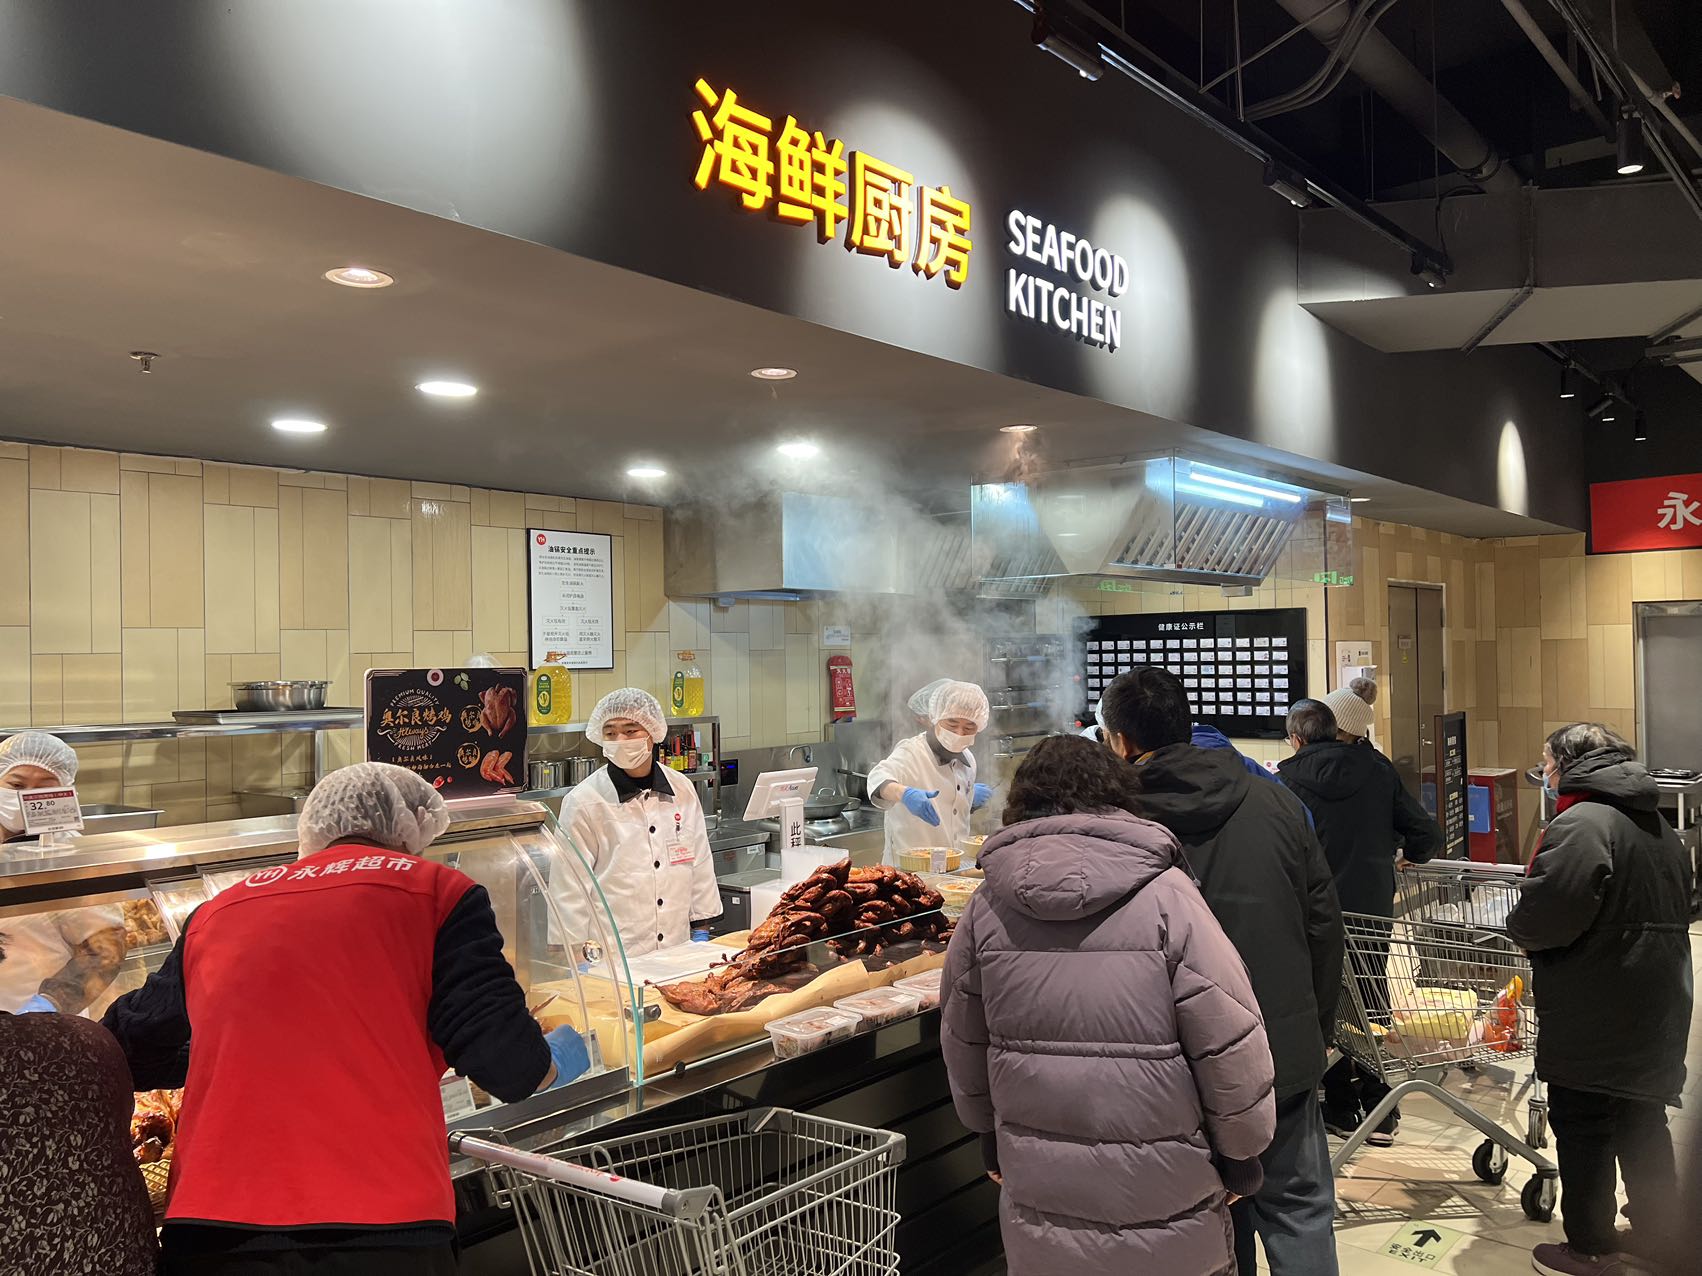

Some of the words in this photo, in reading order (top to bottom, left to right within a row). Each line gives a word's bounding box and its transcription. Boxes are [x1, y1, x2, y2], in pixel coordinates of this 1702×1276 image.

[692, 77, 973, 287] 海鲜厨房
[1007, 209, 1129, 295] SEAFOOD
[1007, 268, 1121, 350] KITCHEN
[1657, 491, 1702, 530] 永
[547, 545, 596, 556] 油锅安全重点提示
[1157, 621, 1204, 632] 健康证公示栏
[390, 689, 415, 707] PREMIUM
[416, 688, 440, 705] QUALITY
[380, 706, 452, 727] 奥尔良烤鸡
[394, 741, 415, 751] FRESH
[416, 740, 432, 751] MEAT
[29, 800, 56, 811] 32.80
[287, 855, 417, 881] 永辉超市
